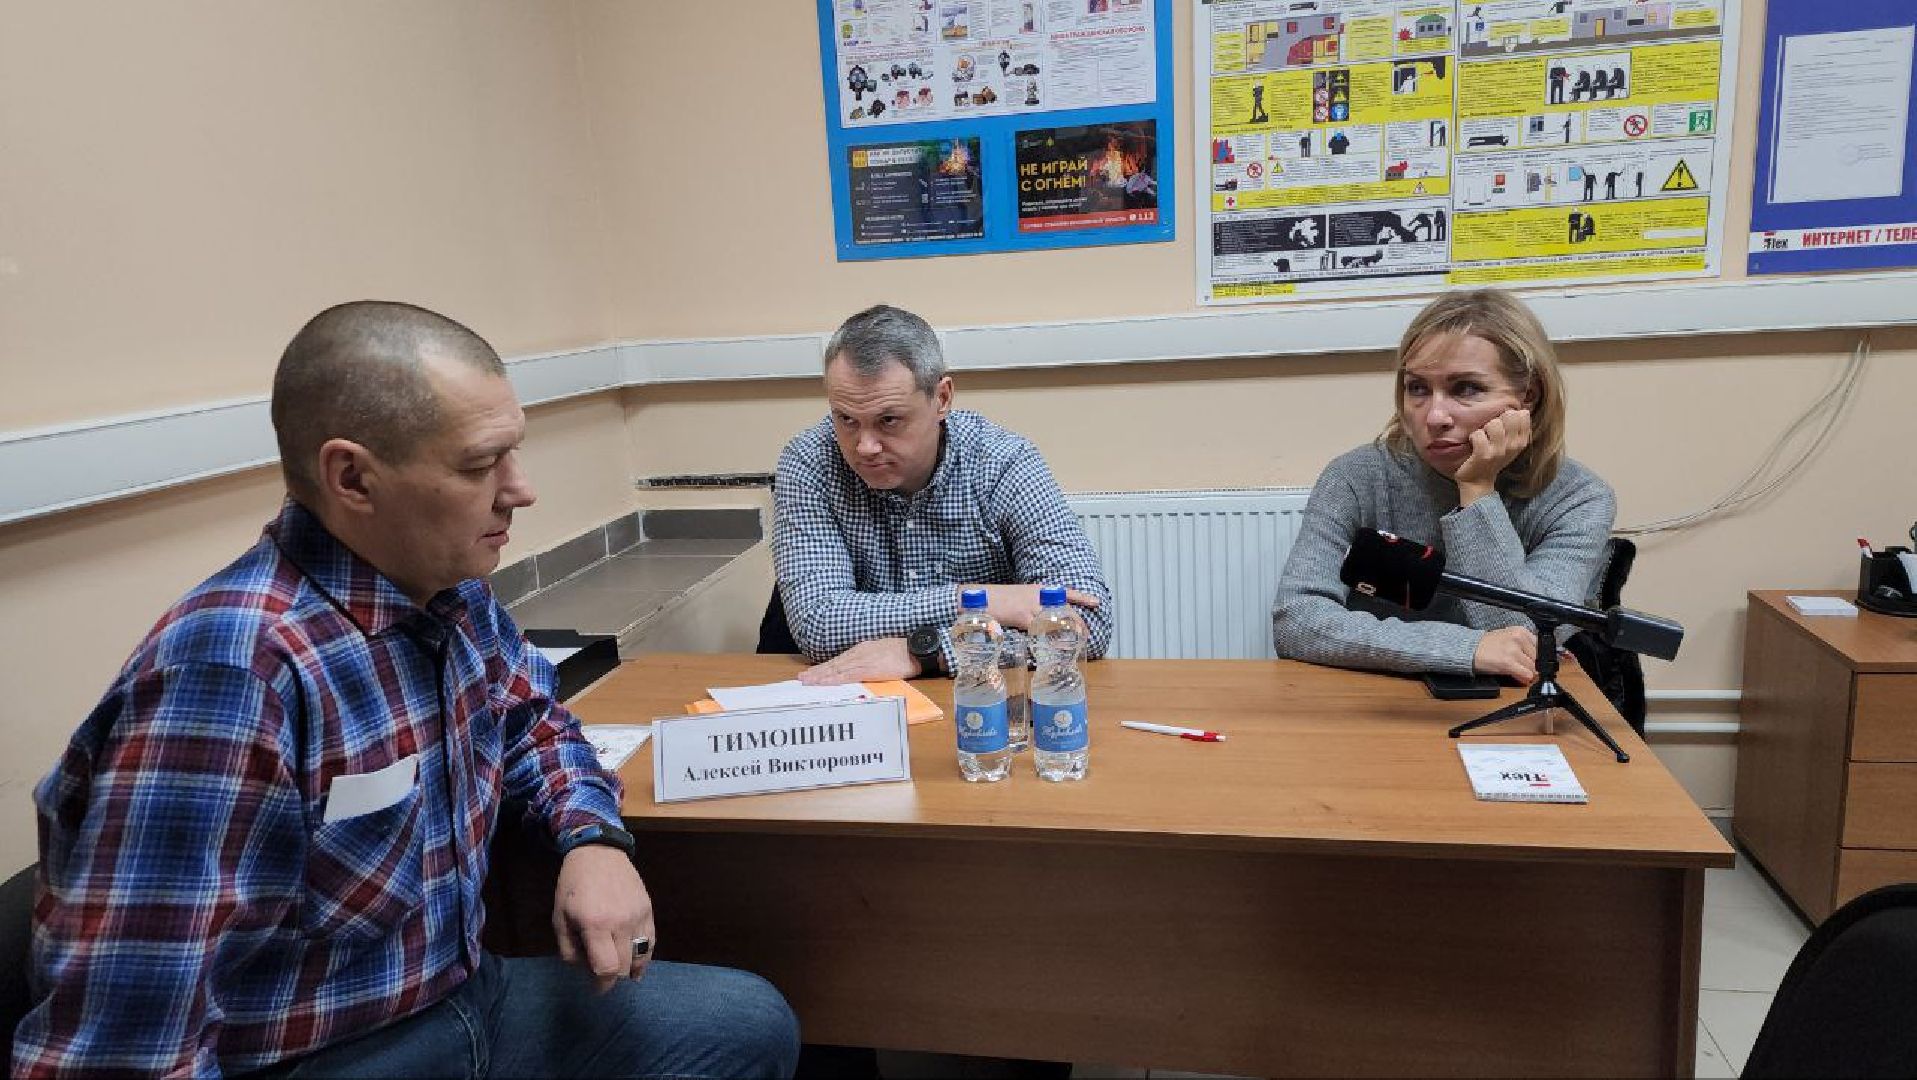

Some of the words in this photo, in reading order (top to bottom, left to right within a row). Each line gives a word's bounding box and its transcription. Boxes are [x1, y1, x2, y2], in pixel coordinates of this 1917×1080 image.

[1020, 163, 1038, 176] НЕ
[1041, 156, 1088, 174] ИГРАЙ
[1021, 180, 1031, 192] С
[1035, 175, 1086, 191] ОГНЁМ!
[1802, 229, 1872, 248] ИНТЕРНЕТ
[707, 721, 855, 754] ТИМОШИН
[683, 758, 762, 783] Алексей
[768, 751, 884, 774] Викторович
